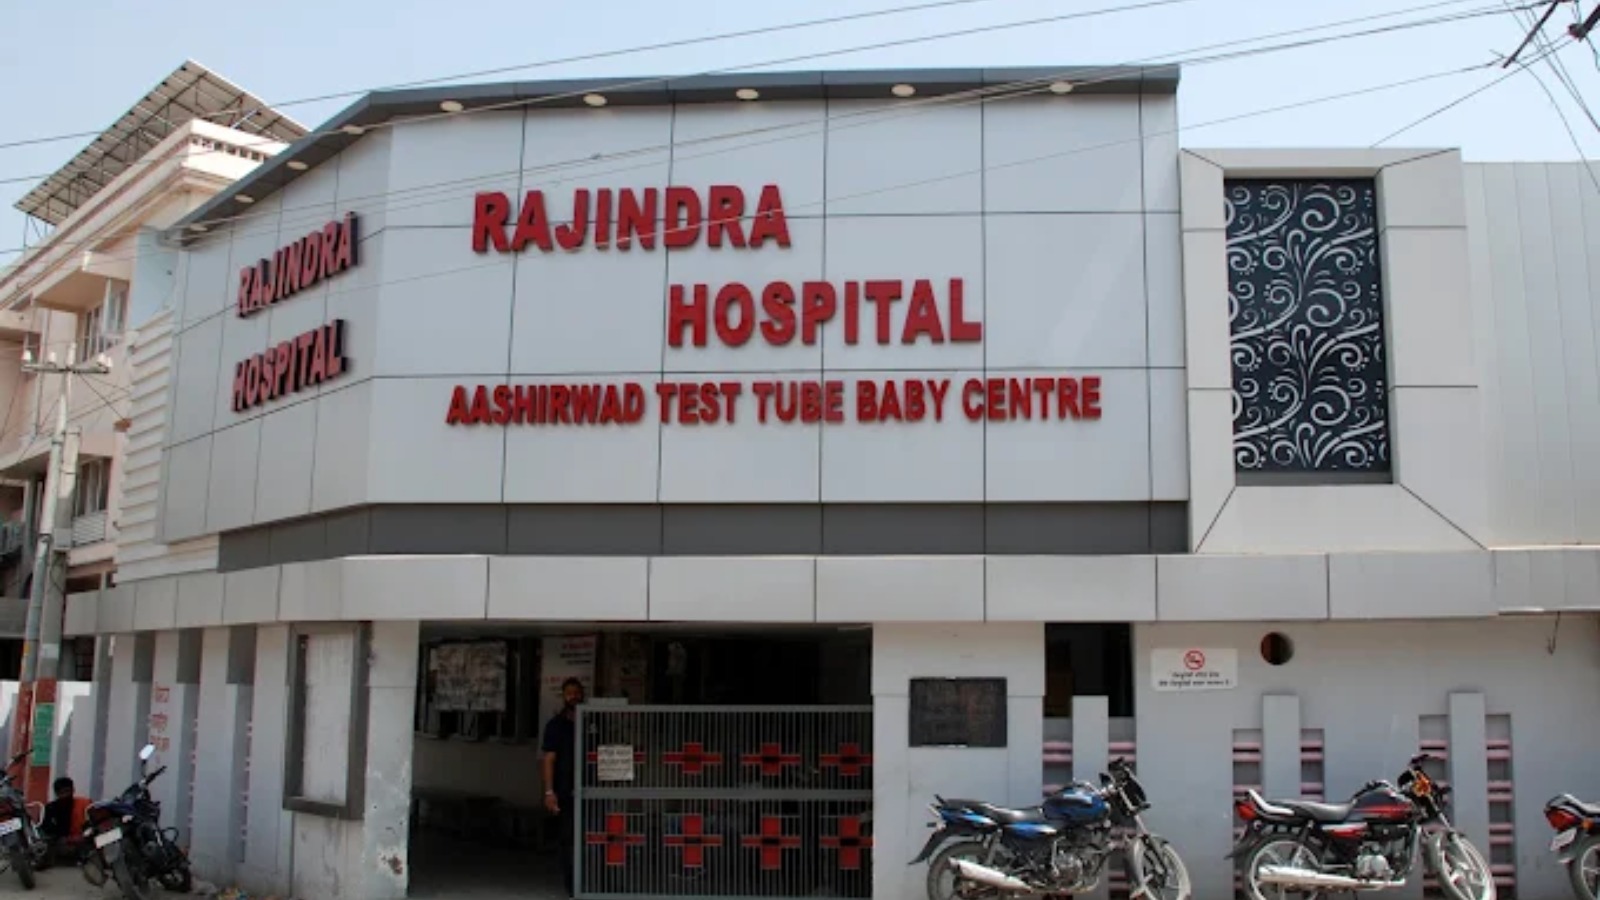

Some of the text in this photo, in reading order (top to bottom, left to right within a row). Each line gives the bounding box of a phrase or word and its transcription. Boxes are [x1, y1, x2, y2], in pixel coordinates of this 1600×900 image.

[473, 184, 791, 251] RAJINDRA
[237, 210, 358, 318] RAJINDRA
[668, 278, 983, 347] HOSPITAL
[231, 318, 350, 412] HOSPITAL
[447, 376, 1102, 426] AASHIRWAD TEST TUBE BABY CENTRE
